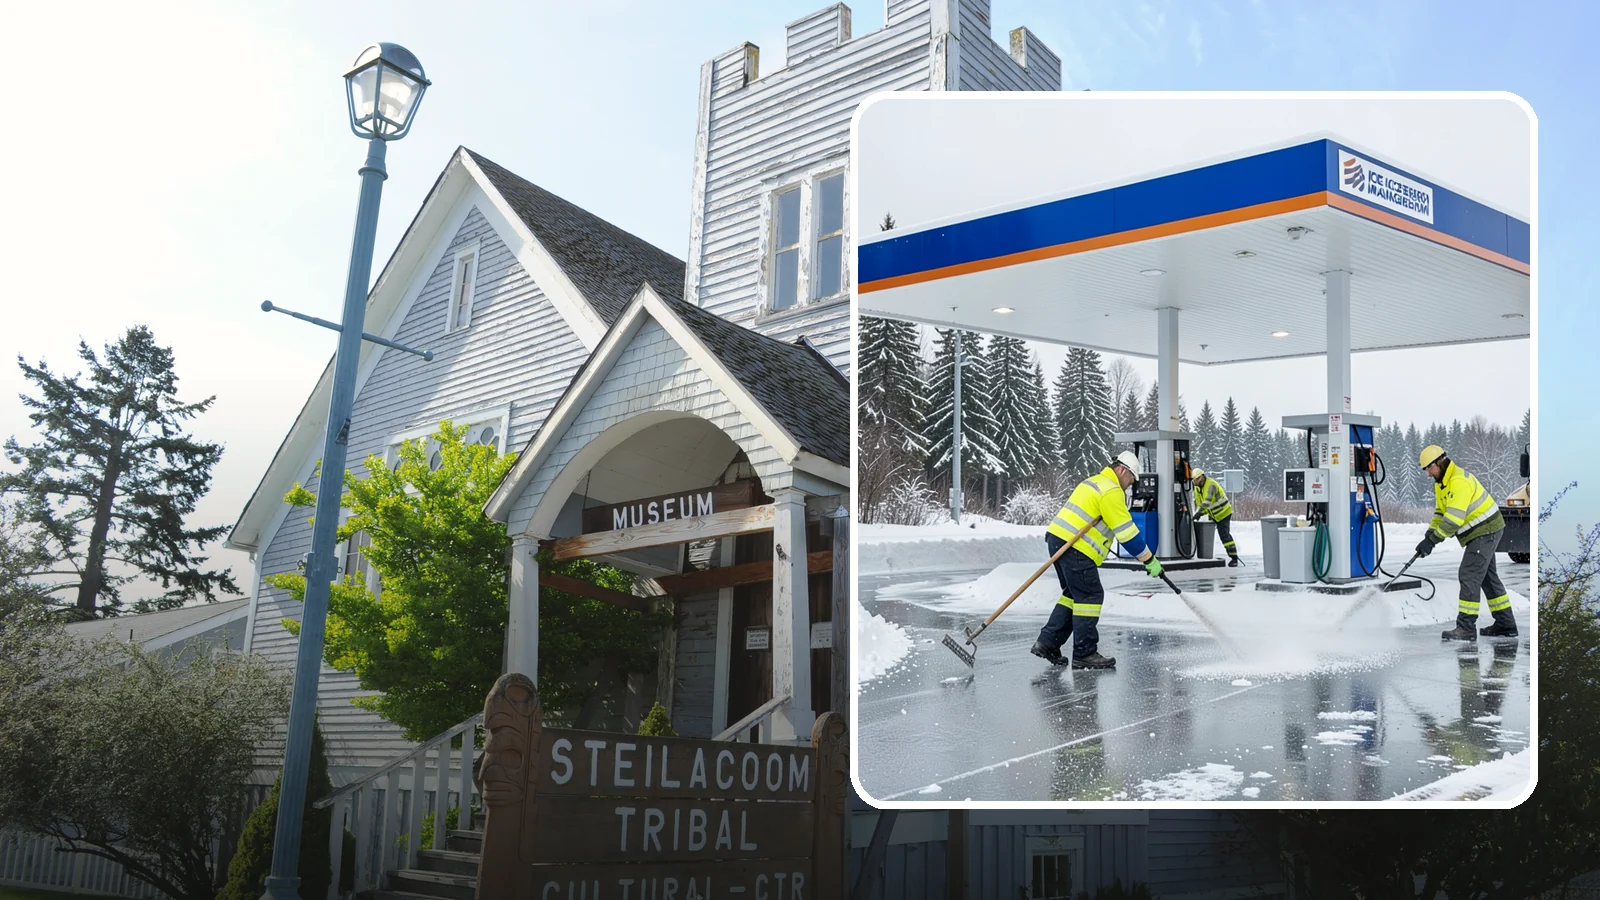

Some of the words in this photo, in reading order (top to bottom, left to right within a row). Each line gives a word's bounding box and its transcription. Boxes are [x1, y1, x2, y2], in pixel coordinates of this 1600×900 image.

[613, 491, 713, 531] MUSEUM
[551, 738, 809, 793] STEILACOOM
[615, 807, 757, 851] TRIBAL
